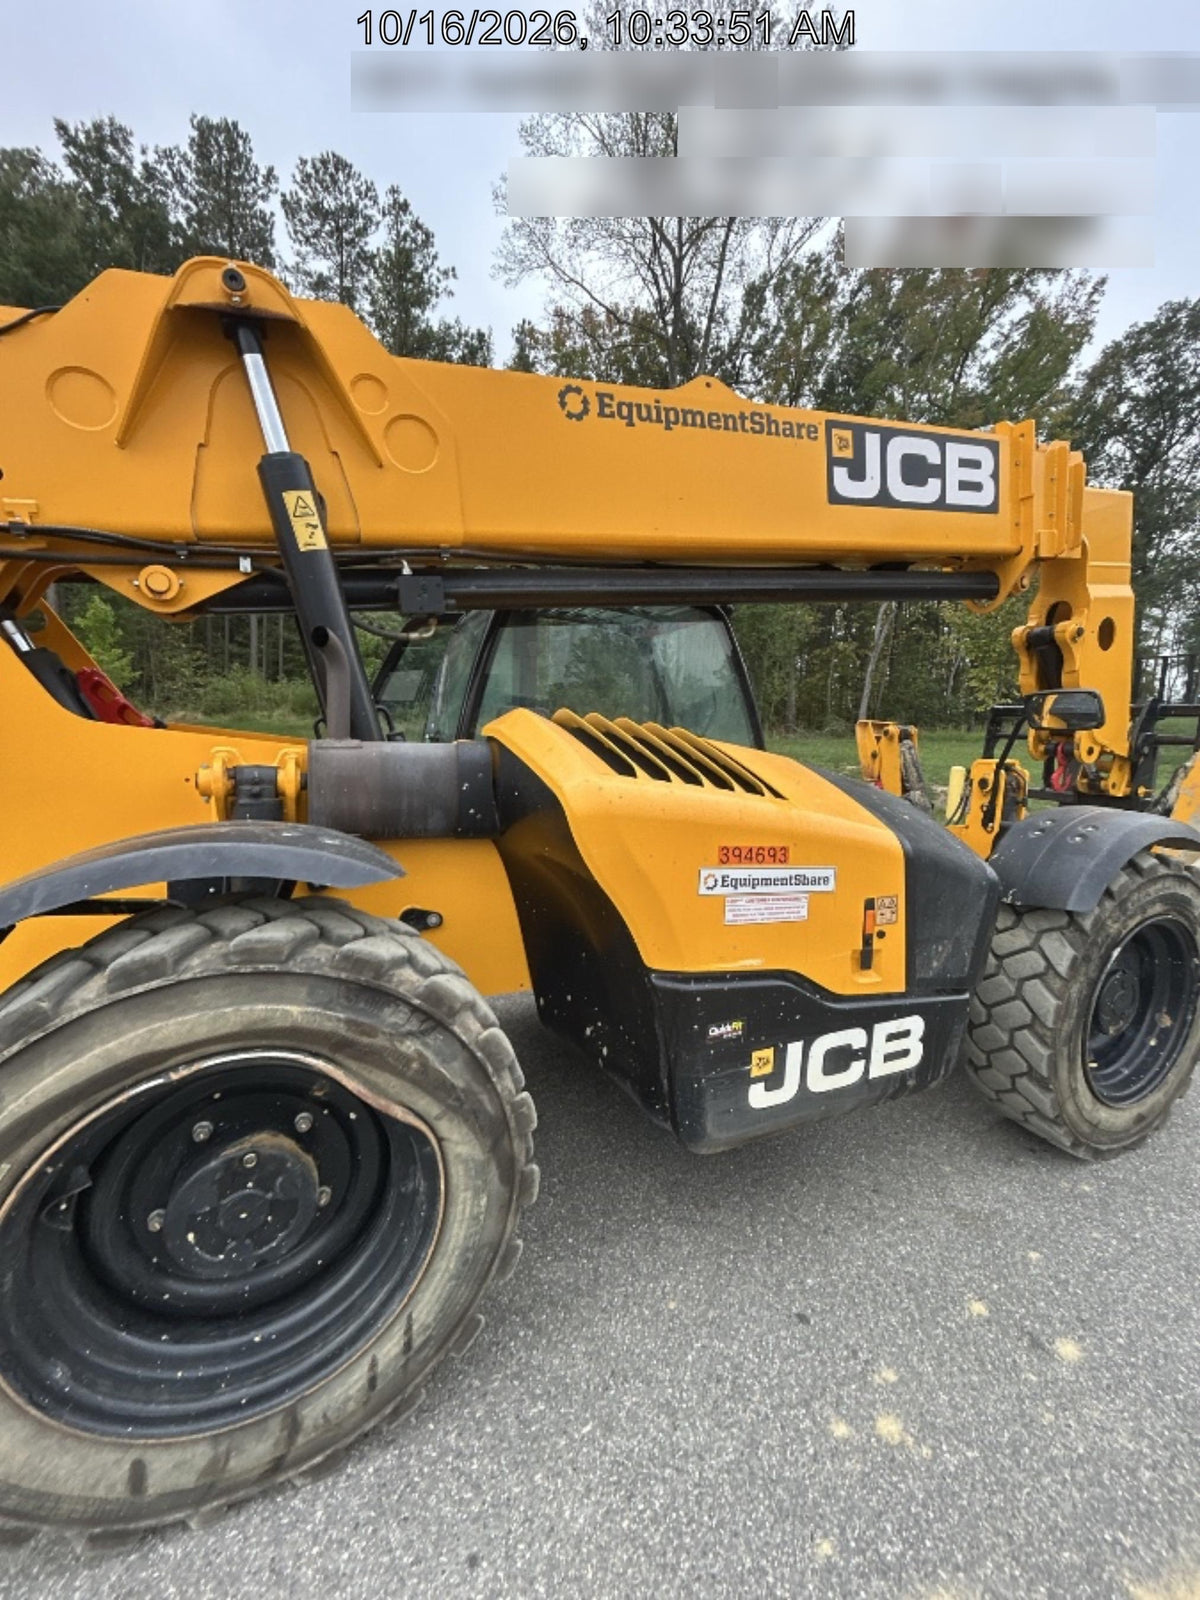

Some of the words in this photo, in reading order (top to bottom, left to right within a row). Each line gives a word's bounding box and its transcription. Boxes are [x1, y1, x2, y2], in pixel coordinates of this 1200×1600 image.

[597, 392, 817, 440] EquipmentShare
[832, 433, 996, 507] JCB
[719, 846, 788, 864] 394693
[720, 874, 830, 890] EquipmentShare
[748, 1015, 925, 1109] JCB
